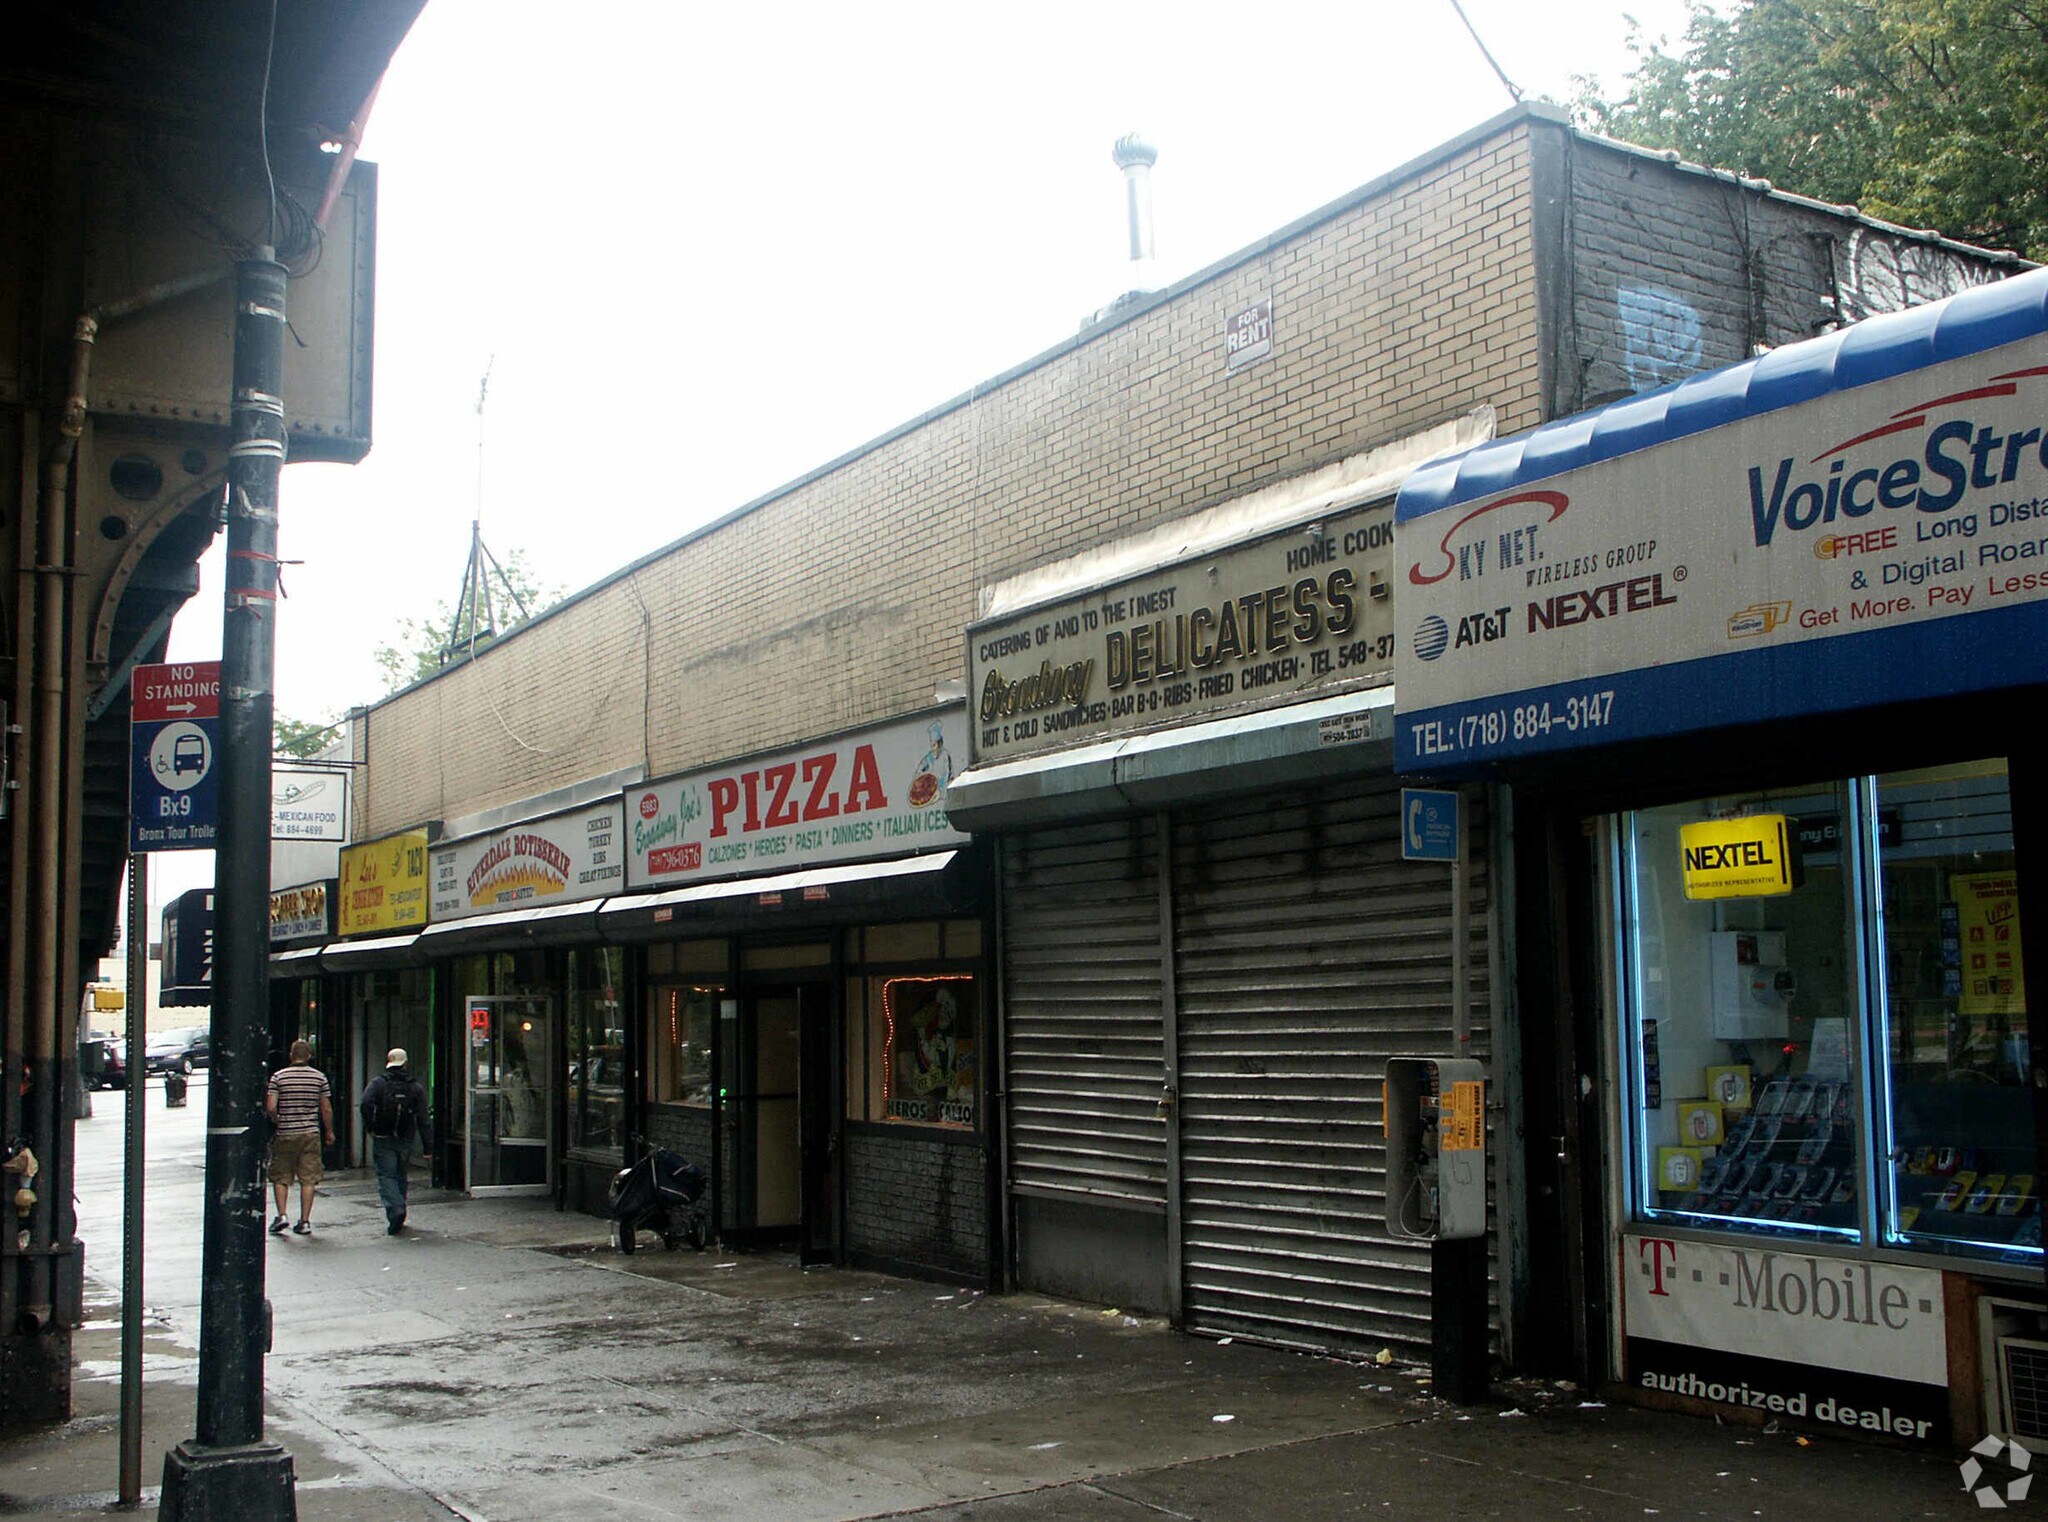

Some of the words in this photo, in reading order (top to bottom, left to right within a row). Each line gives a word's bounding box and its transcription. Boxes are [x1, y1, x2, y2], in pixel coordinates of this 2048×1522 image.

[1227, 318, 1269, 354] RENT
[1238, 308, 1258, 328] FOR
[1286, 538, 1336, 573] HOME
[1832, 526, 1898, 559] FREE
[1916, 514, 1978, 543] Long
[1526, 554, 1599, 588] WIRELESS
[1606, 540, 1658, 569] GROUP
[1850, 570, 1868, 590] &
[1883, 550, 1965, 585] Digital
[1455, 606, 1512, 649] AT&T
[1527, 573, 1678, 634] NEXTEL
[1799, 606, 1839, 629] Get
[1851, 596, 1916, 621] More.
[1928, 584, 1974, 607] Pay
[980, 630, 1031, 662] CATERING
[1035, 624, 1050, 646] OF
[1054, 617, 1080, 640] AND
[1082, 609, 1098, 633] TO
[1102, 600, 1126, 626] THE
[145, 681, 220, 700] STANDING
[171, 665, 194, 681] NO
[982, 728, 999, 748] HOT
[1014, 719, 1038, 740] COLD
[1043, 701, 1107, 734] SANDWICHES
[1112, 694, 1134, 719] BAR
[1163, 683, 1192, 709] RIBS
[1199, 672, 1234, 700] FRIED
[1241, 656, 1299, 690] CHICKEN
[1513, 690, 1615, 741] 884-3147
[160, 795, 191, 817] Bx9
[707, 743, 889, 839] PIZZA
[139, 827, 165, 841] Bronx
[168, 826, 187, 838] Tour
[189, 824, 216, 838] Trolle
[315, 812, 336, 823] FOOD
[634, 812, 677, 856] Broadway
[708, 843, 747, 864] CALZONES
[754, 836, 787, 857] HEROES
[795, 831, 823, 851] PASTA
[831, 821, 873, 845] DINNERS
[884, 813, 920, 838] ITALIAN
[924, 809, 949, 832] ICES
[589, 833, 612, 849] TURKEY
[1686, 840, 1774, 871] NEXTEL
[467, 836, 511, 897] RIVERDALE
[513, 834, 571, 880] ROTISSERIE
[886, 1100, 928, 1120] HEROS
[939, 1102, 974, 1122] CALZO
[1641, 1371, 1807, 1418] authorized
[1815, 1397, 1933, 1439] dealer
